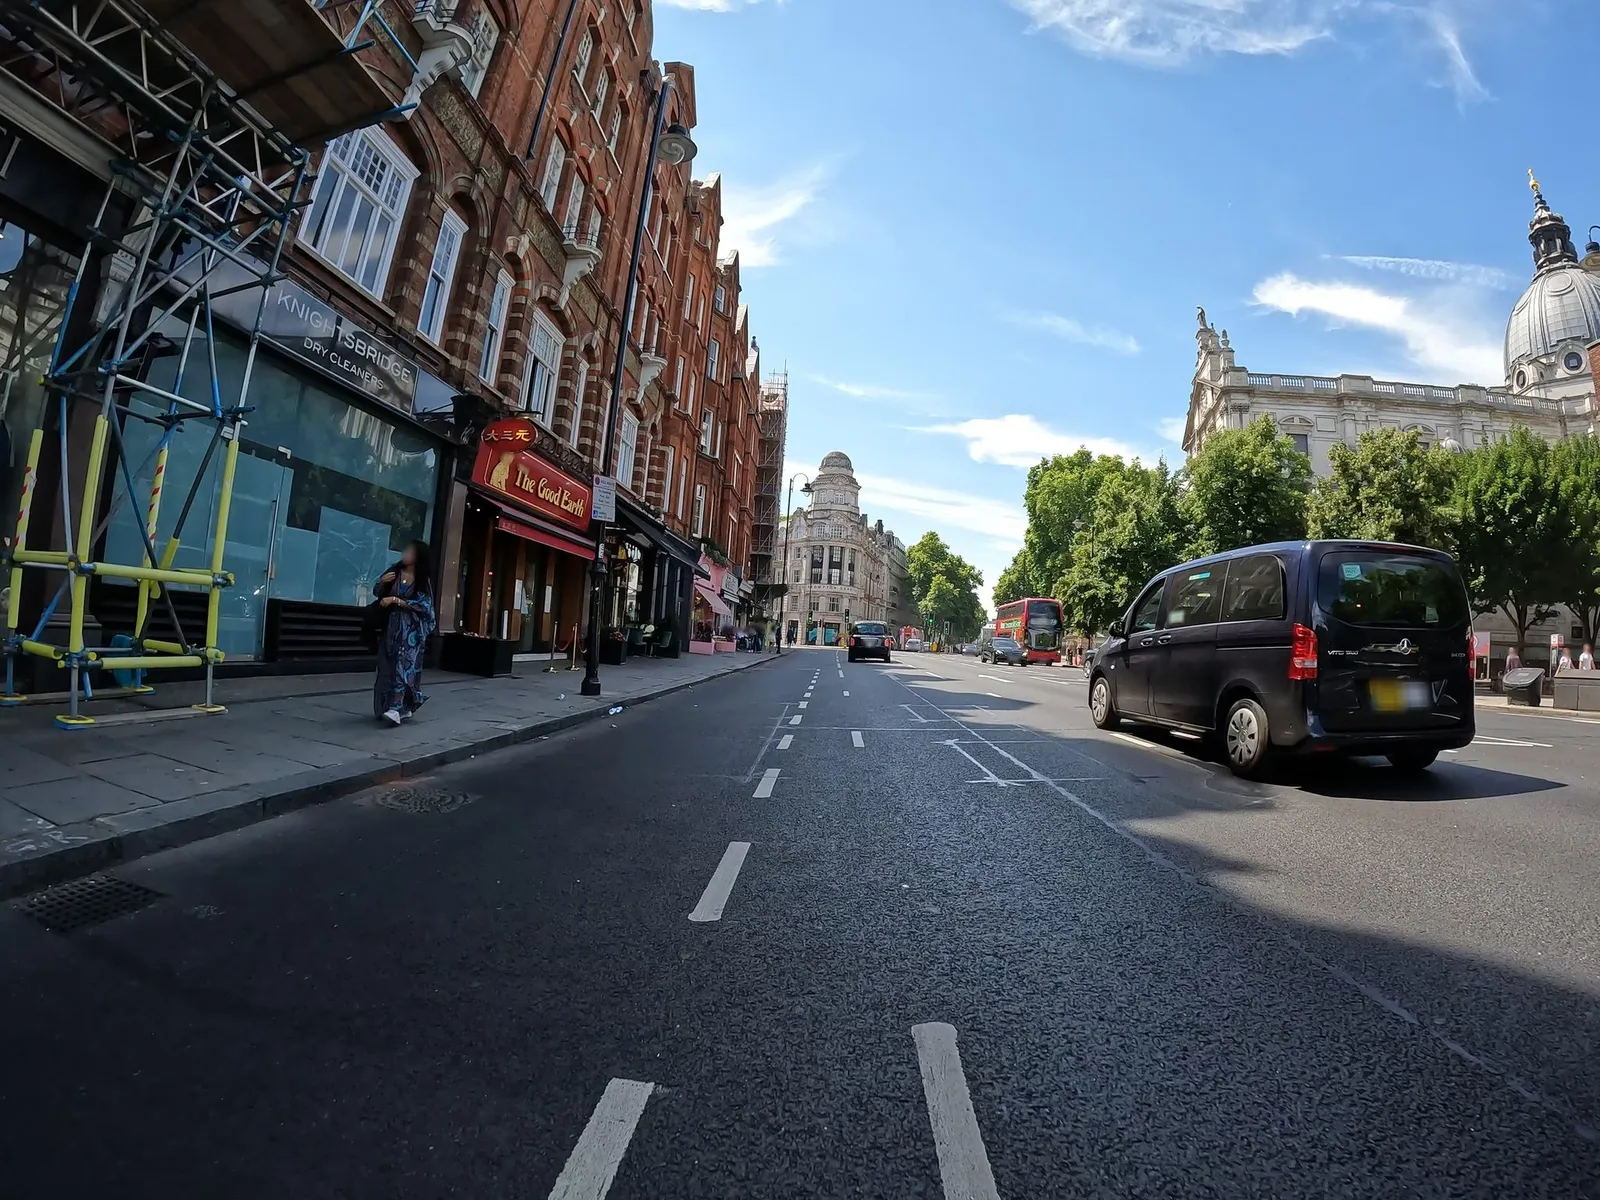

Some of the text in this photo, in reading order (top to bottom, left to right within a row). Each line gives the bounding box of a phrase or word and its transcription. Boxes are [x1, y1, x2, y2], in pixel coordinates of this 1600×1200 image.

[278, 289, 411, 384] KNIGHTSBRIDGE
[303, 336, 384, 390] DRY CLEANERS
[484, 429, 532, 441] 大三元
[515, 464, 585, 518] The Good Earth
